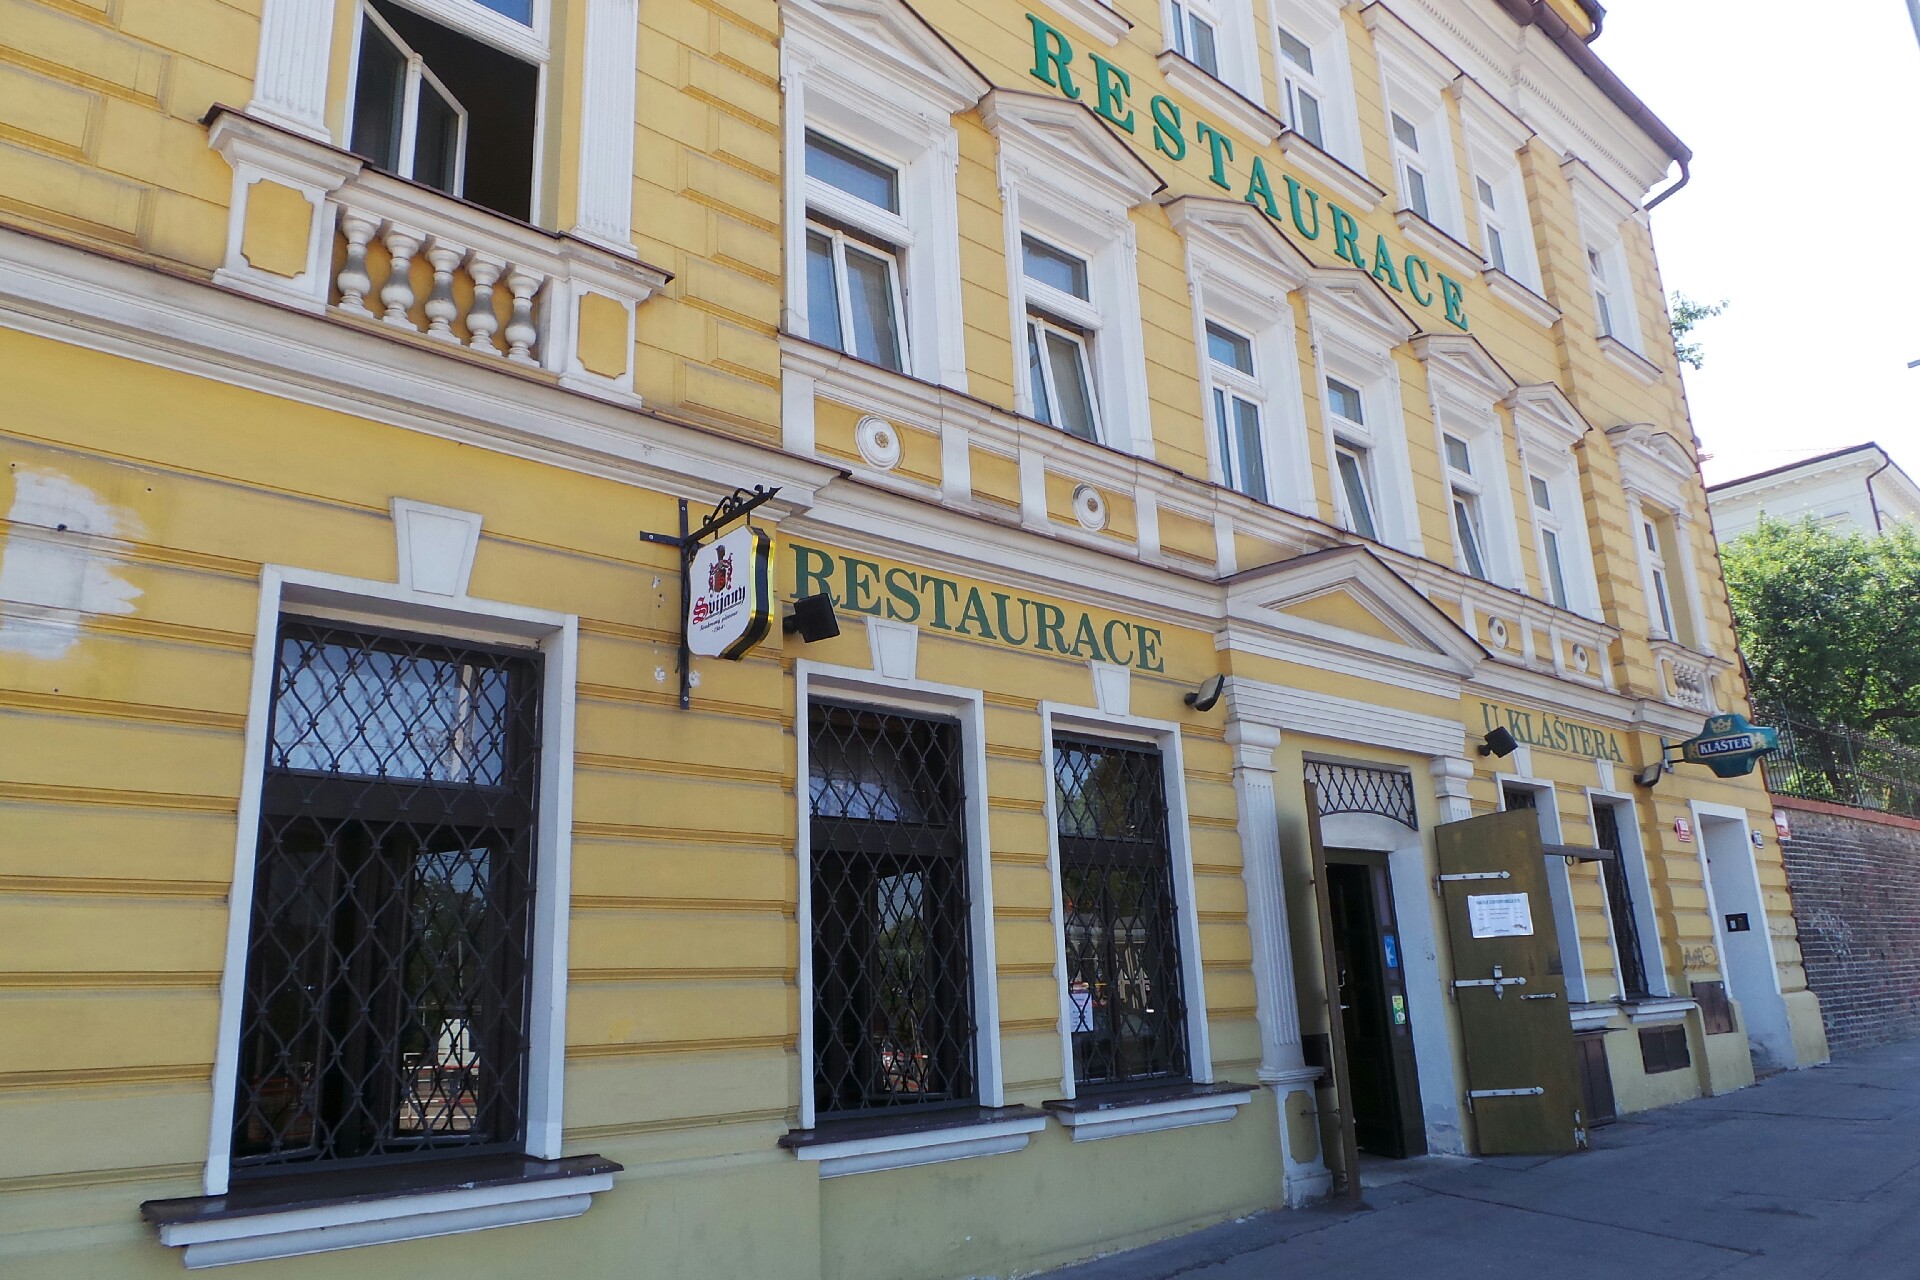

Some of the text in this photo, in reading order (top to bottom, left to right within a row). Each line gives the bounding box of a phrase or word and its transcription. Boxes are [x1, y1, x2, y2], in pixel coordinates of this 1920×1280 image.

[1026, 13, 1469, 331] RESTAURACE
[693, 586, 746, 625] Svijany
[789, 544, 1165, 673] RESTAURACE
[1480, 702, 1624, 763] U KLÁŠTERA
